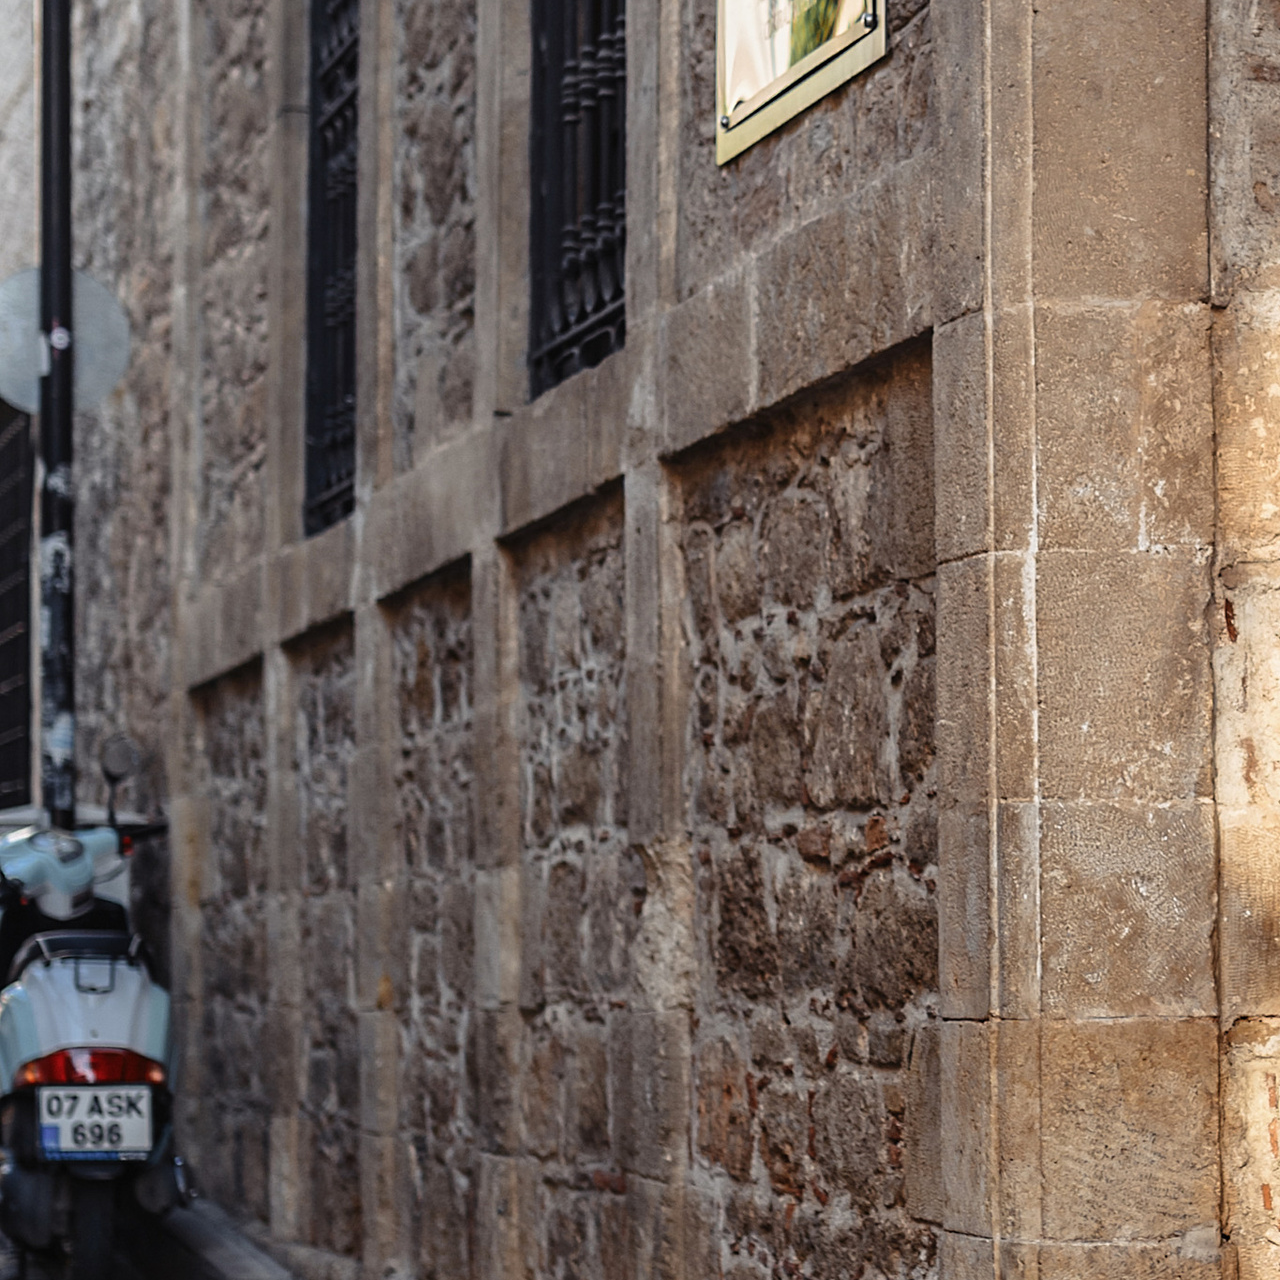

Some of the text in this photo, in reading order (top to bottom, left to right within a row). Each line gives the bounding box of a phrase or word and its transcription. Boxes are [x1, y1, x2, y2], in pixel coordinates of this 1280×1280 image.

[47, 1093, 145, 1119] 07 ASK
[72, 1121, 124, 1148] 696
